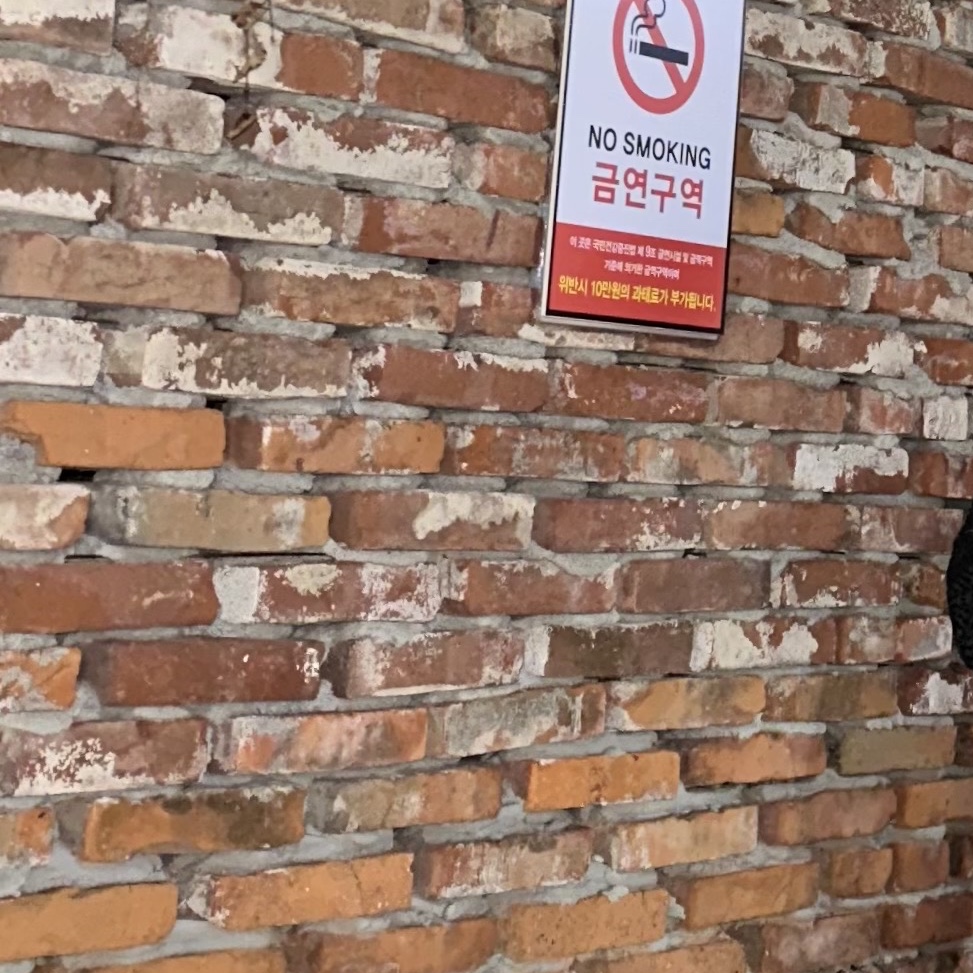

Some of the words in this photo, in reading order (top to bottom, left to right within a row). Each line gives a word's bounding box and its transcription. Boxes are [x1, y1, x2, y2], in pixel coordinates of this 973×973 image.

[588, 124, 617, 152] NO
[623, 131, 711, 170] SMOKING
[591, 161, 704, 220] 금연구역
[558, 275, 588, 296] 위반시
[590, 279, 631, 302] 10만원의
[631, 284, 669, 306] 과태료가
